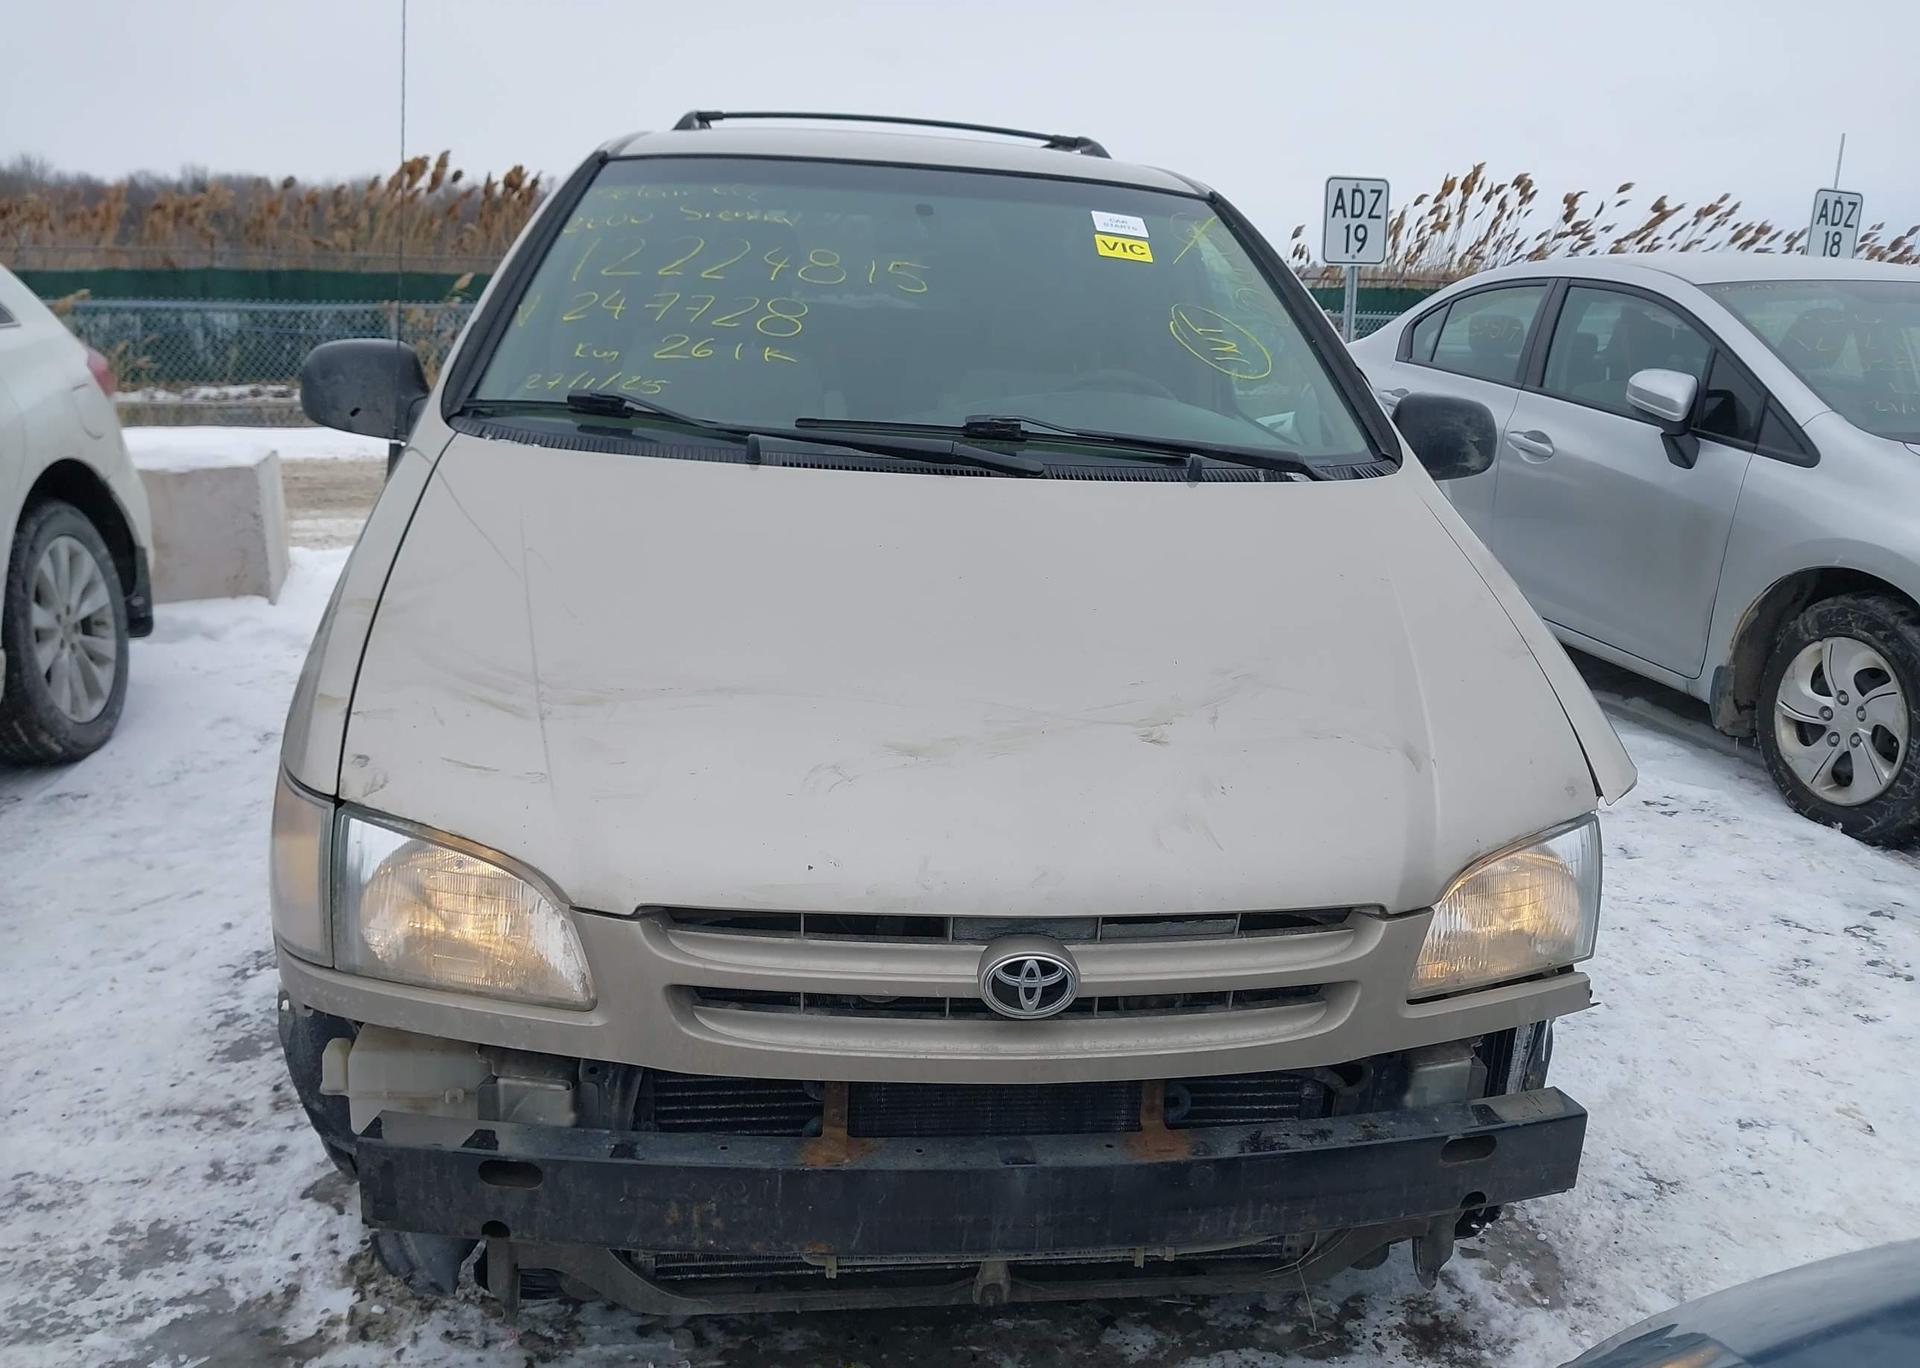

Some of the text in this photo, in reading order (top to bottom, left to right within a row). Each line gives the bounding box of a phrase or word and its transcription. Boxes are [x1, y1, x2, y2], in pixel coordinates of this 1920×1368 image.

[1331, 187, 1383, 219] ADZ
[1816, 198, 1858, 228] ADZ
[1101, 240, 1146, 256] VIC
[1344, 223, 1368, 254] 19
[1822, 230, 1842, 257] 18
